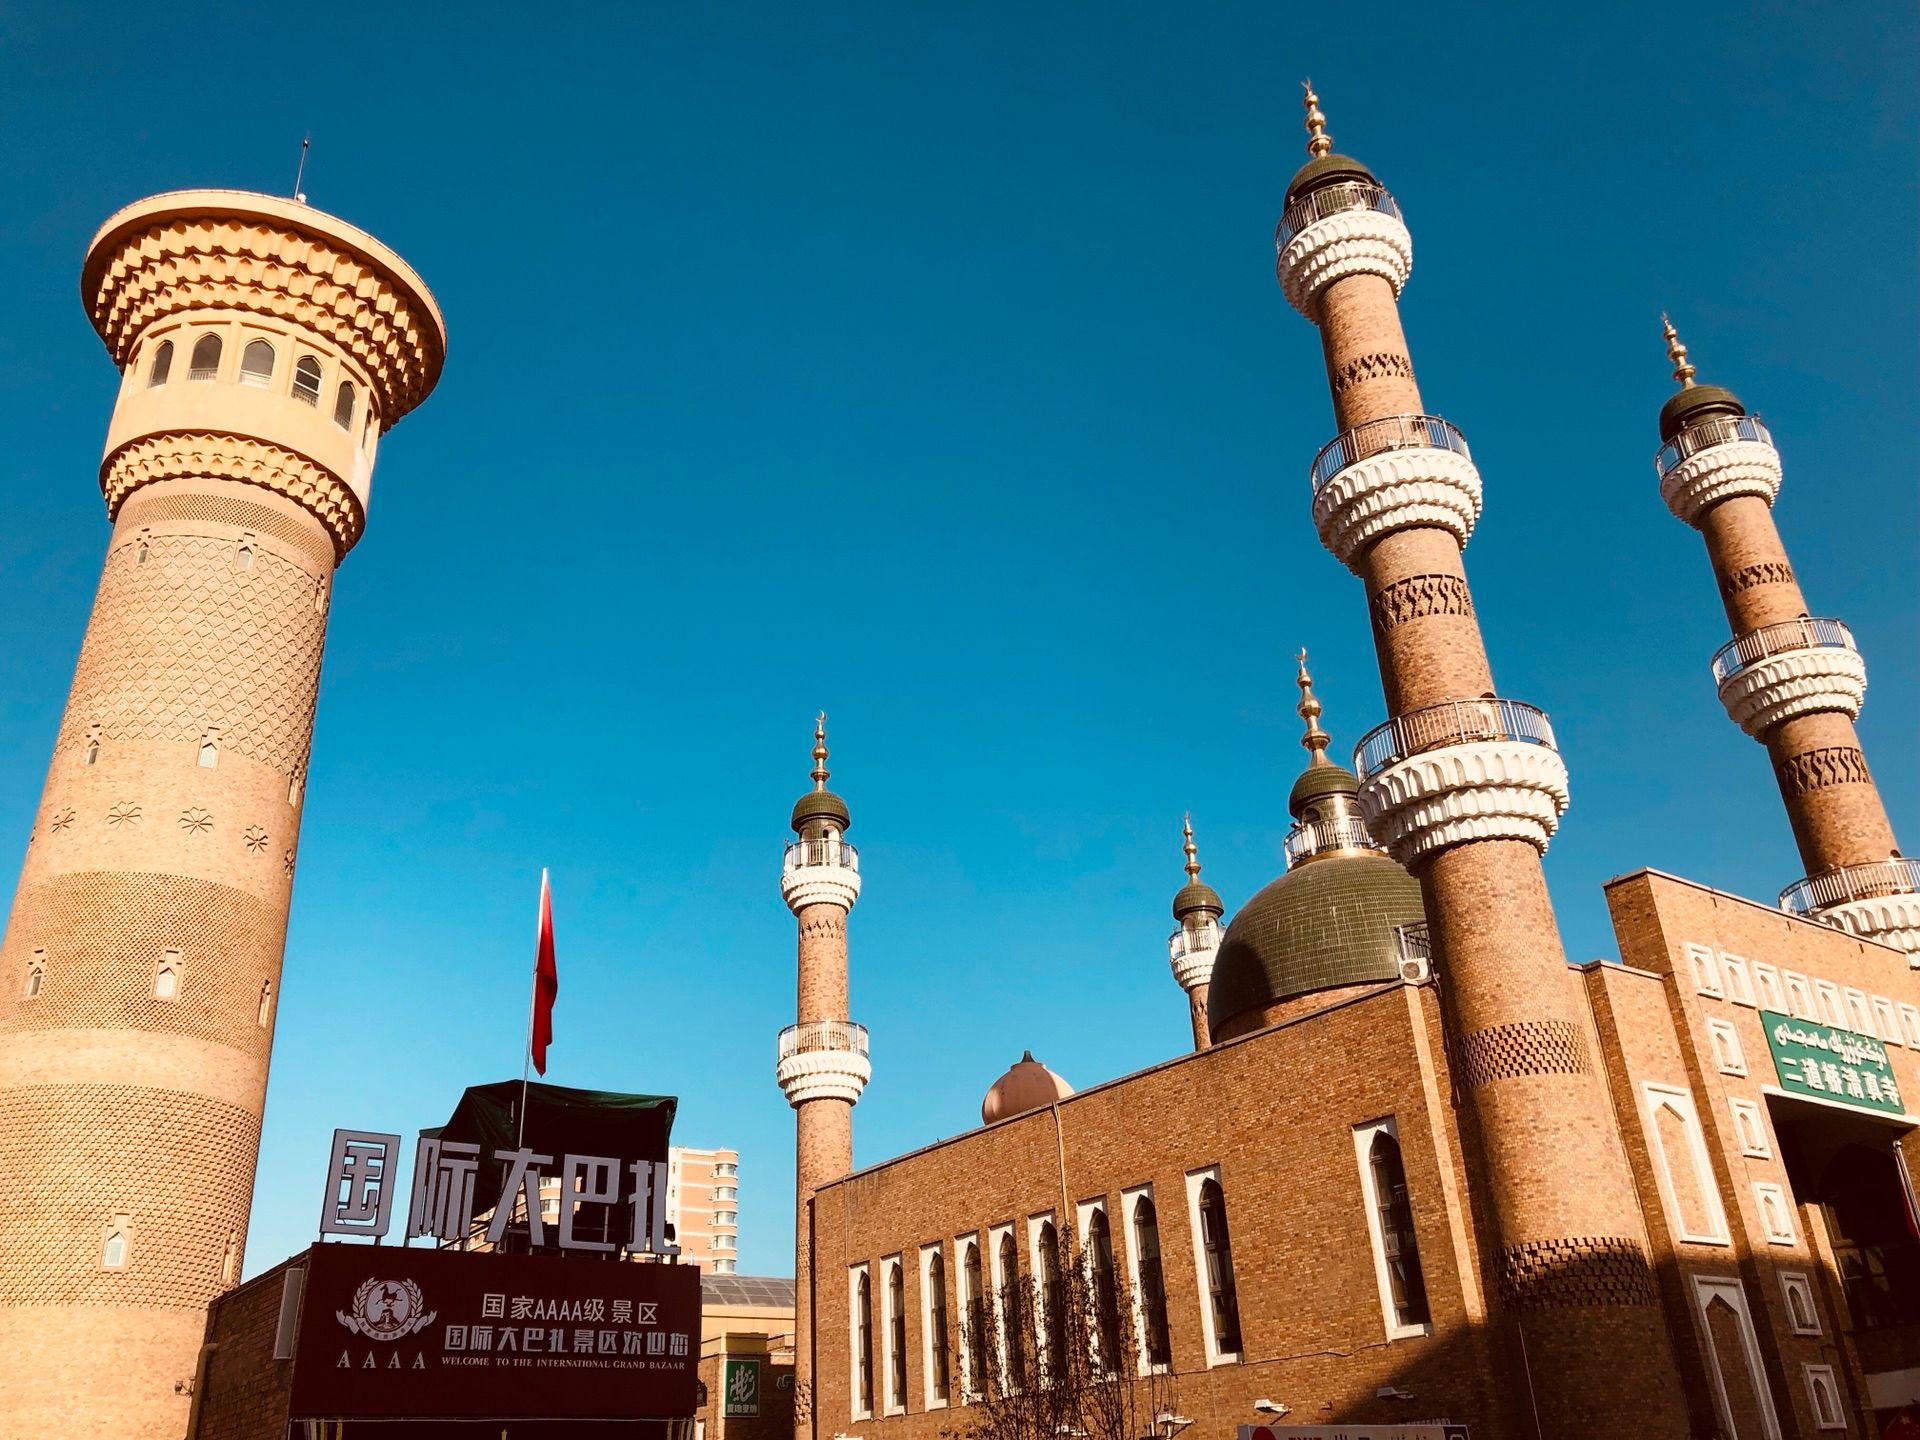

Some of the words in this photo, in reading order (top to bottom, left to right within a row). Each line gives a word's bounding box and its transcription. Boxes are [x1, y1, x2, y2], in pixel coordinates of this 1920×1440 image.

[319, 1128, 681, 1255] 国际大巴扎
[444, 1324, 689, 1356] 国际大巴扎景区欢迎您
[441, 1356, 490, 1366] WELCOME
[496, 1357, 510, 1366] TO
[513, 1358, 533, 1367] THE
[536, 1358, 611, 1368] INTERNATIONAL
[613, 1360, 646, 1369] GRAND
[649, 1361, 686, 1370] BAZAAR
